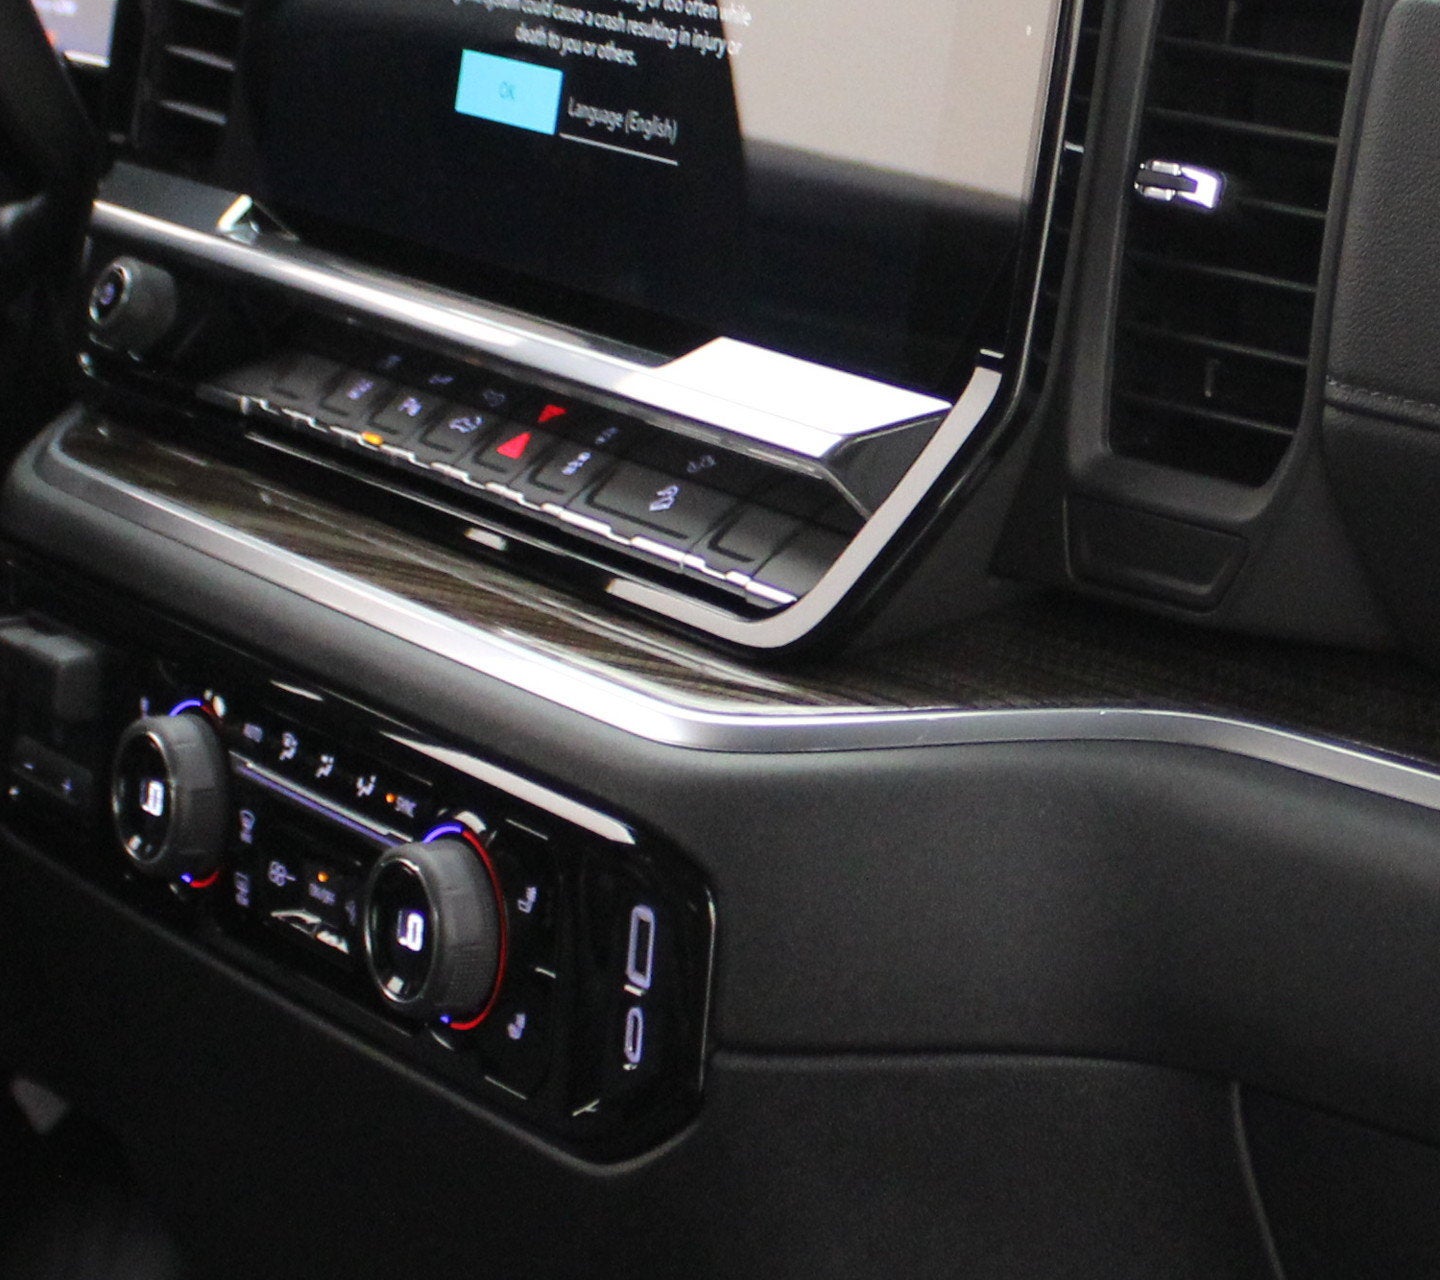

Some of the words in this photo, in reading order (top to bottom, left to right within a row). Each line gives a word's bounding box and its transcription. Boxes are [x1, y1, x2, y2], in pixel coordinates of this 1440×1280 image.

[560, 34, 583, 57] you
[582, 39, 597, 58] or
[626, 17, 679, 50] resulting
[678, 23, 691, 47] in
[691, 26, 727, 60] injury
[568, 96, 623, 133] Language
[624, 107, 679, 146] (English)
